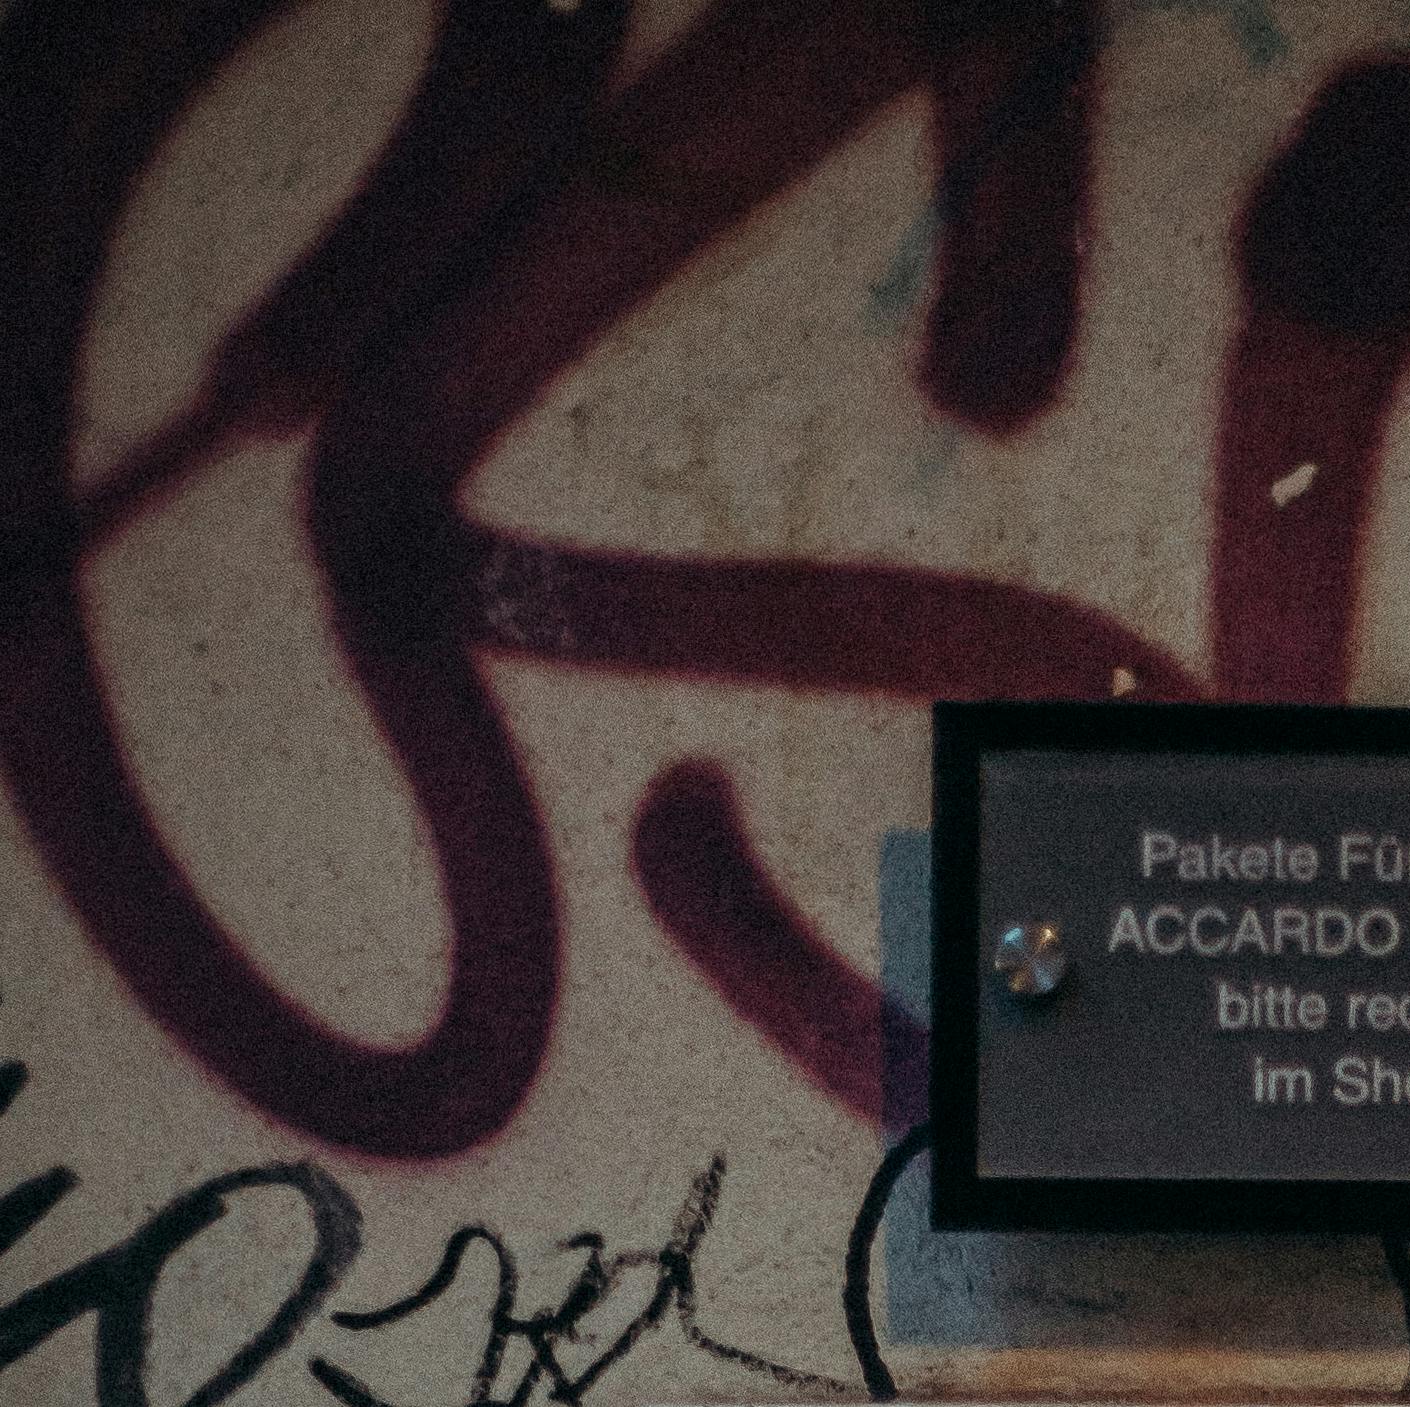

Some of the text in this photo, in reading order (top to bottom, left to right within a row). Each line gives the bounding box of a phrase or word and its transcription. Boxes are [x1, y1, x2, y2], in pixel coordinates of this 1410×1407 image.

[1140, 832, 1318, 882] Pakete
[1108, 906, 1401, 959] ACCARDO
[1217, 983, 1327, 1031] bitte
[1253, 1057, 1314, 1104] im
